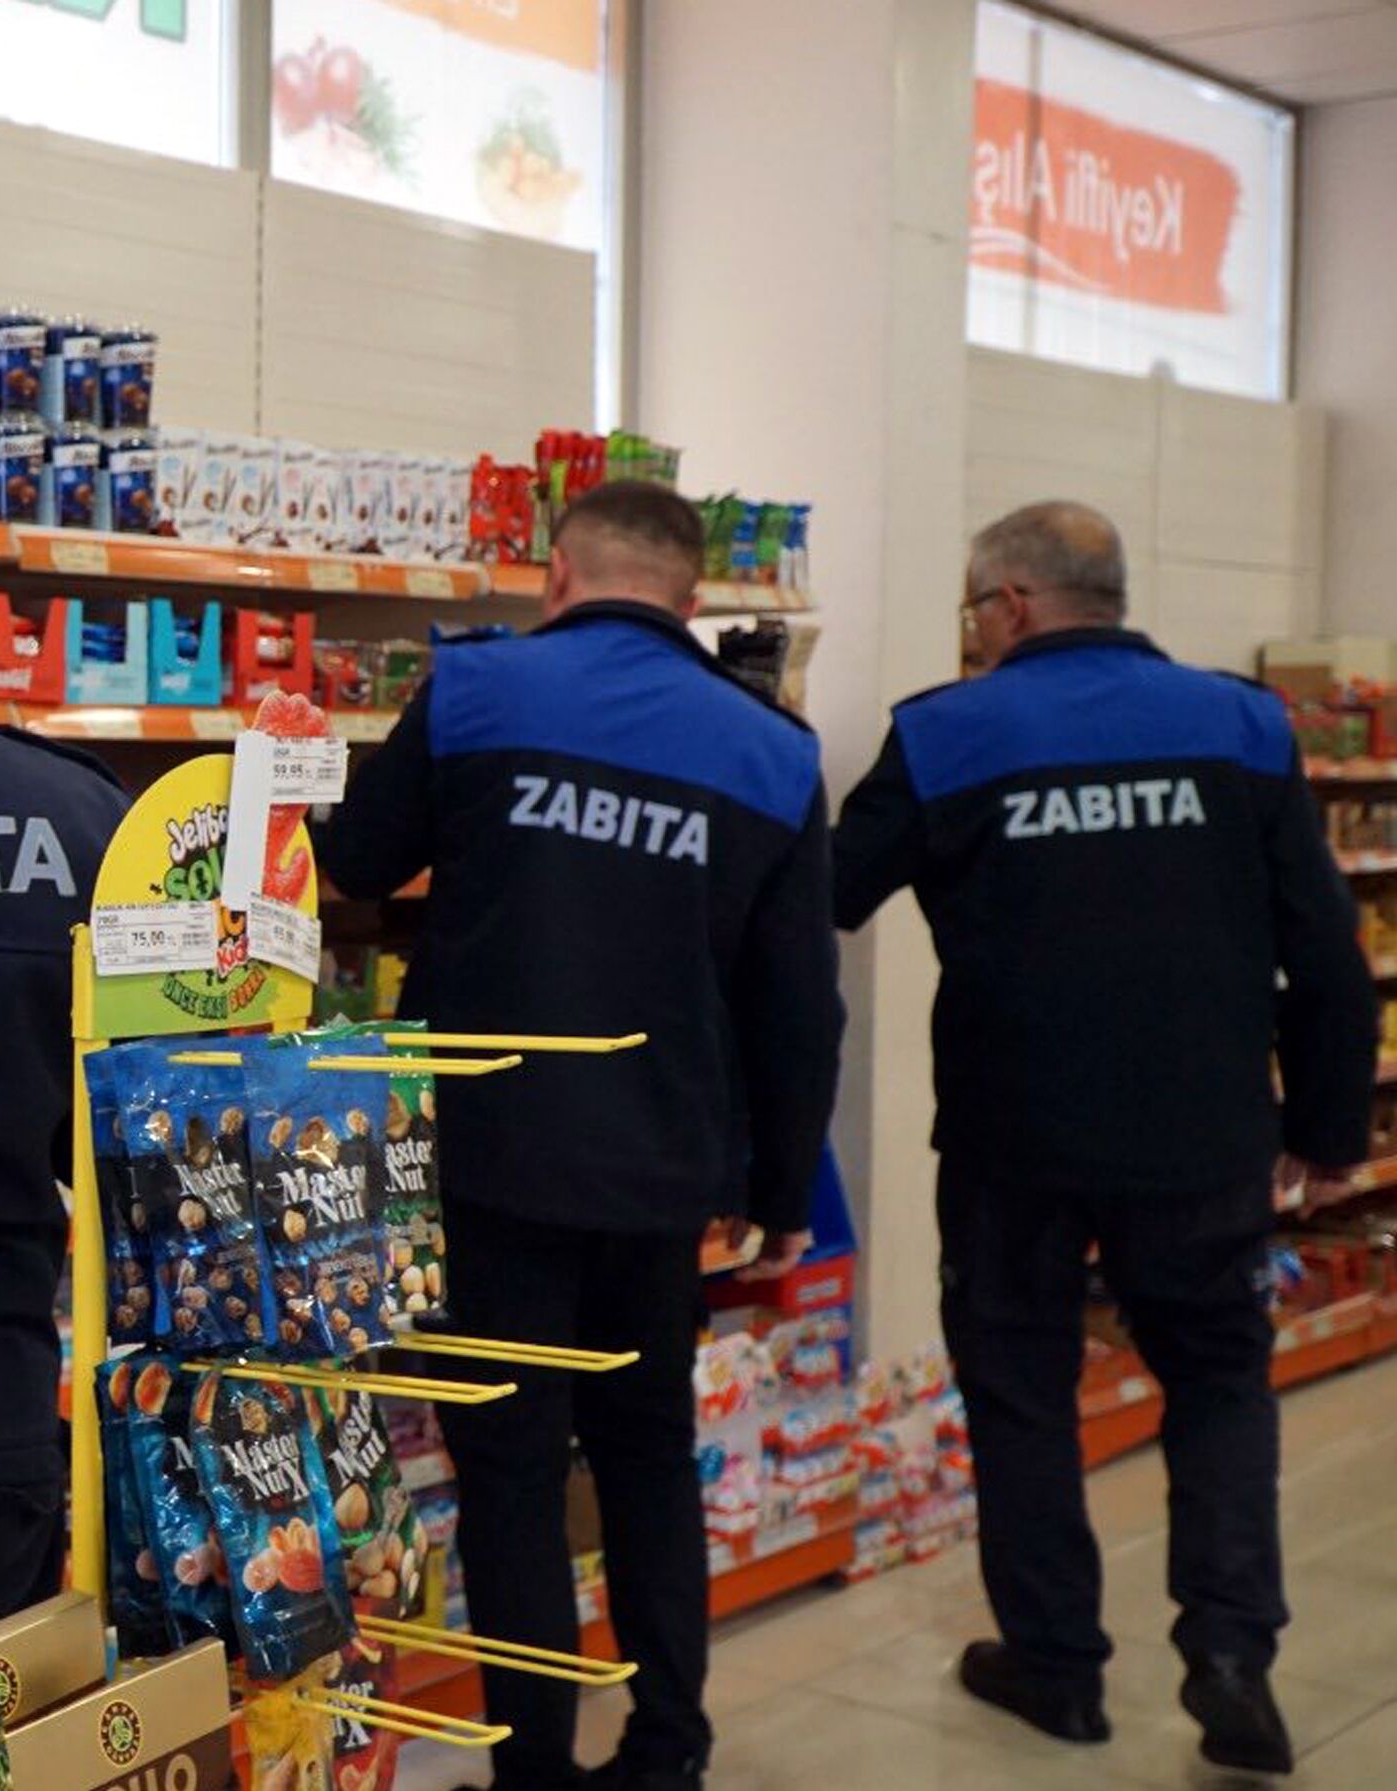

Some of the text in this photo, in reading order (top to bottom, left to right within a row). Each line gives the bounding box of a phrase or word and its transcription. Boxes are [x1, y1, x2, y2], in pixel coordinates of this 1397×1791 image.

[509, 774, 709, 867] ZABITA
[1003, 777, 1207, 839] ZABITA
[166, 802, 228, 864] Jelibo
[216, 932, 249, 978] Kid
[275, 1160, 367, 1206] Master
[309, 1190, 365, 1227] Nut
[220, 1433, 301, 1477] Master
